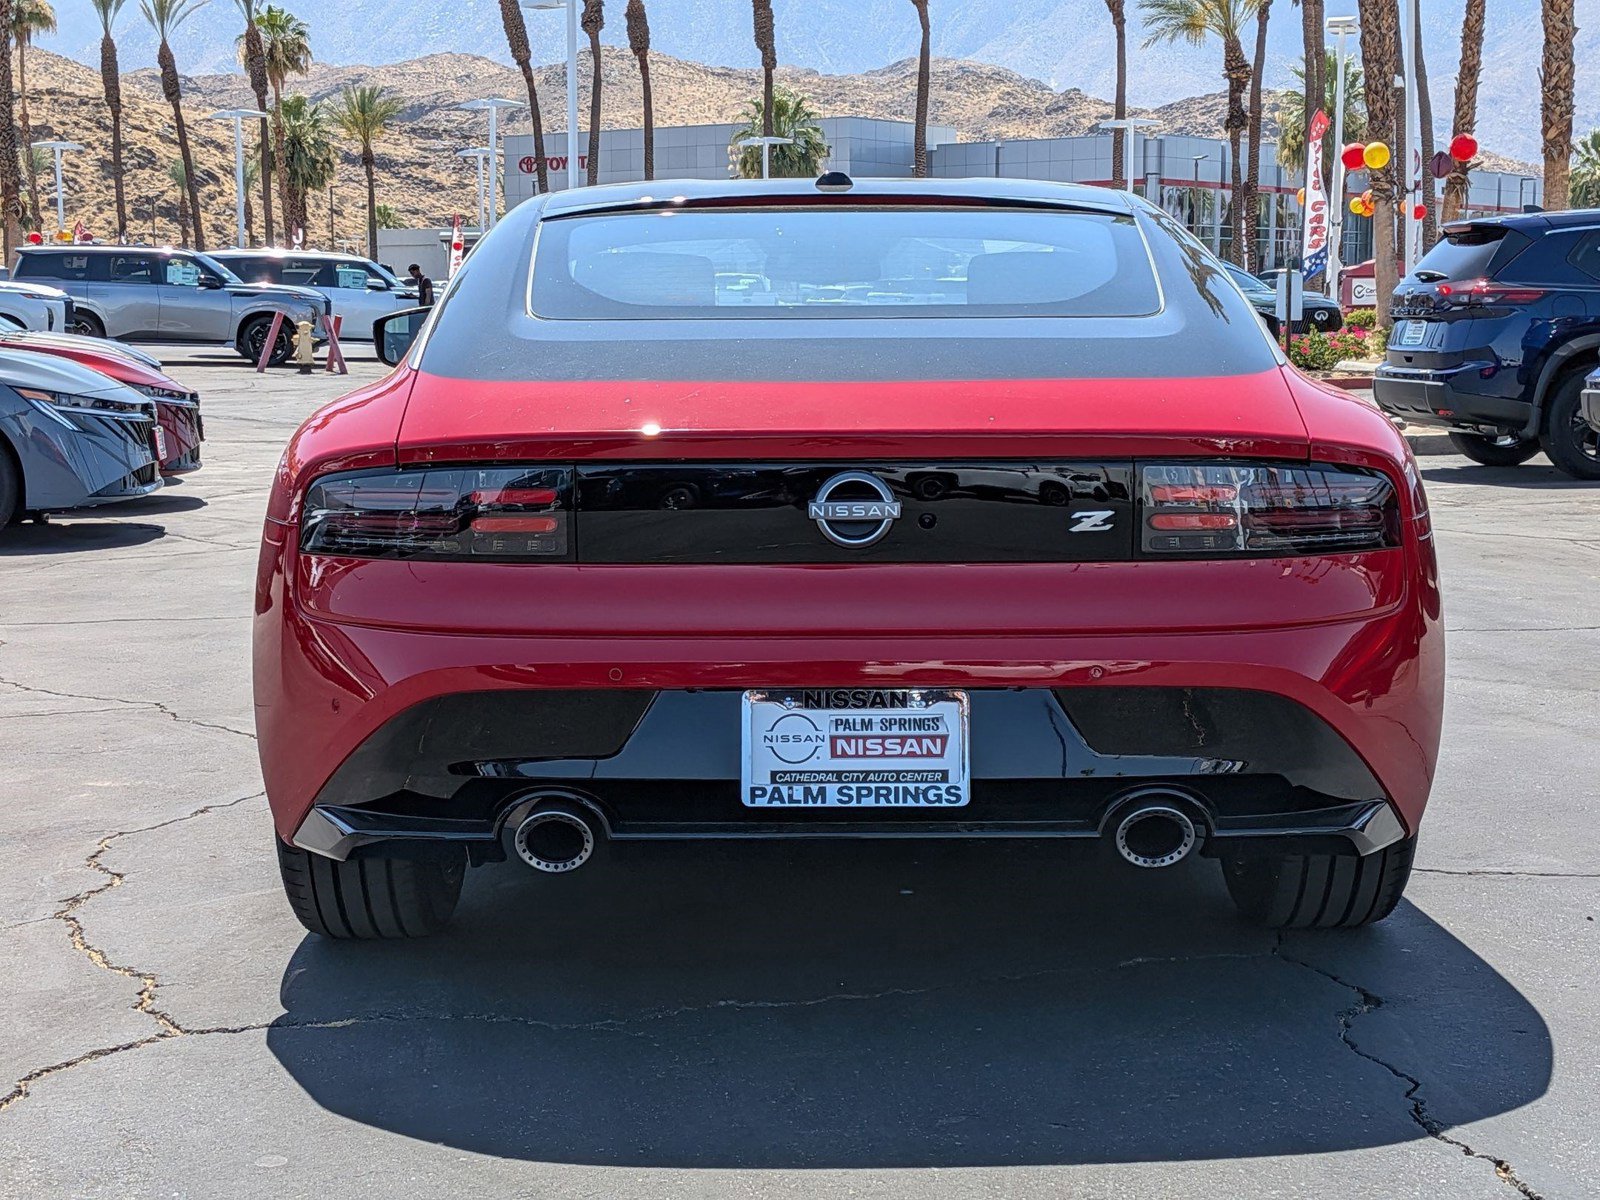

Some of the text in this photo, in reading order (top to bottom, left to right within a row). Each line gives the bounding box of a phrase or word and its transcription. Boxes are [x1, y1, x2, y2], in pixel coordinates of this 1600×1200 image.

[1308, 200, 1327, 249] CARS
[811, 505, 898, 517] NISSAN
[1068, 510, 1116, 532] Z
[803, 690, 908, 709] NISSAN
[834, 717, 940, 732] PALM SPRINGS
[763, 734, 825, 743] NISSAN
[836, 739, 942, 755] NISSAN
[775, 772, 942, 782] CATHEDRAL CITY AUTO CENTER
[750, 785, 962, 805] PALM SPRINGS
